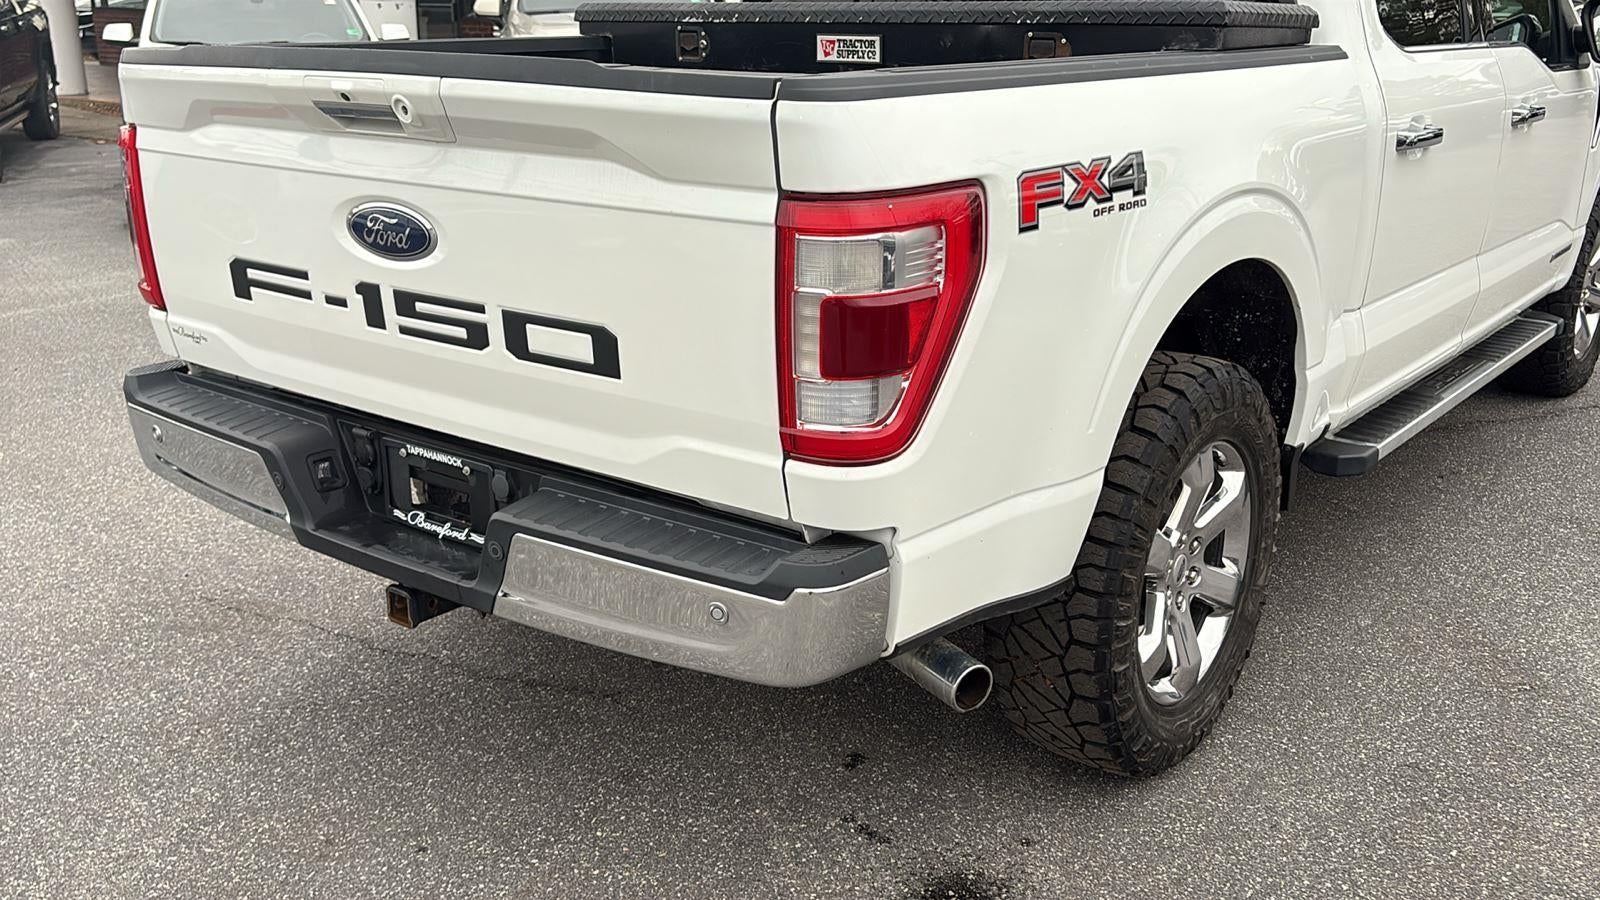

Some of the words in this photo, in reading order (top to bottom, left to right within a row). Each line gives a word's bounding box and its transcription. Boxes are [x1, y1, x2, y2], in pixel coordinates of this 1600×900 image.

[836, 39, 877, 49] TRACTOR
[836, 50, 866, 59] SUPPLY
[1016, 150, 1148, 234] FX4
[1093, 206, 1115, 218] OFF
[1118, 199, 1147, 212] ROAD
[363, 213, 411, 249] Ford
[229, 257, 622, 379] F-150
[406, 444, 463, 468] TAPPAHANNOCK
[407, 510, 468, 541] Bareford
